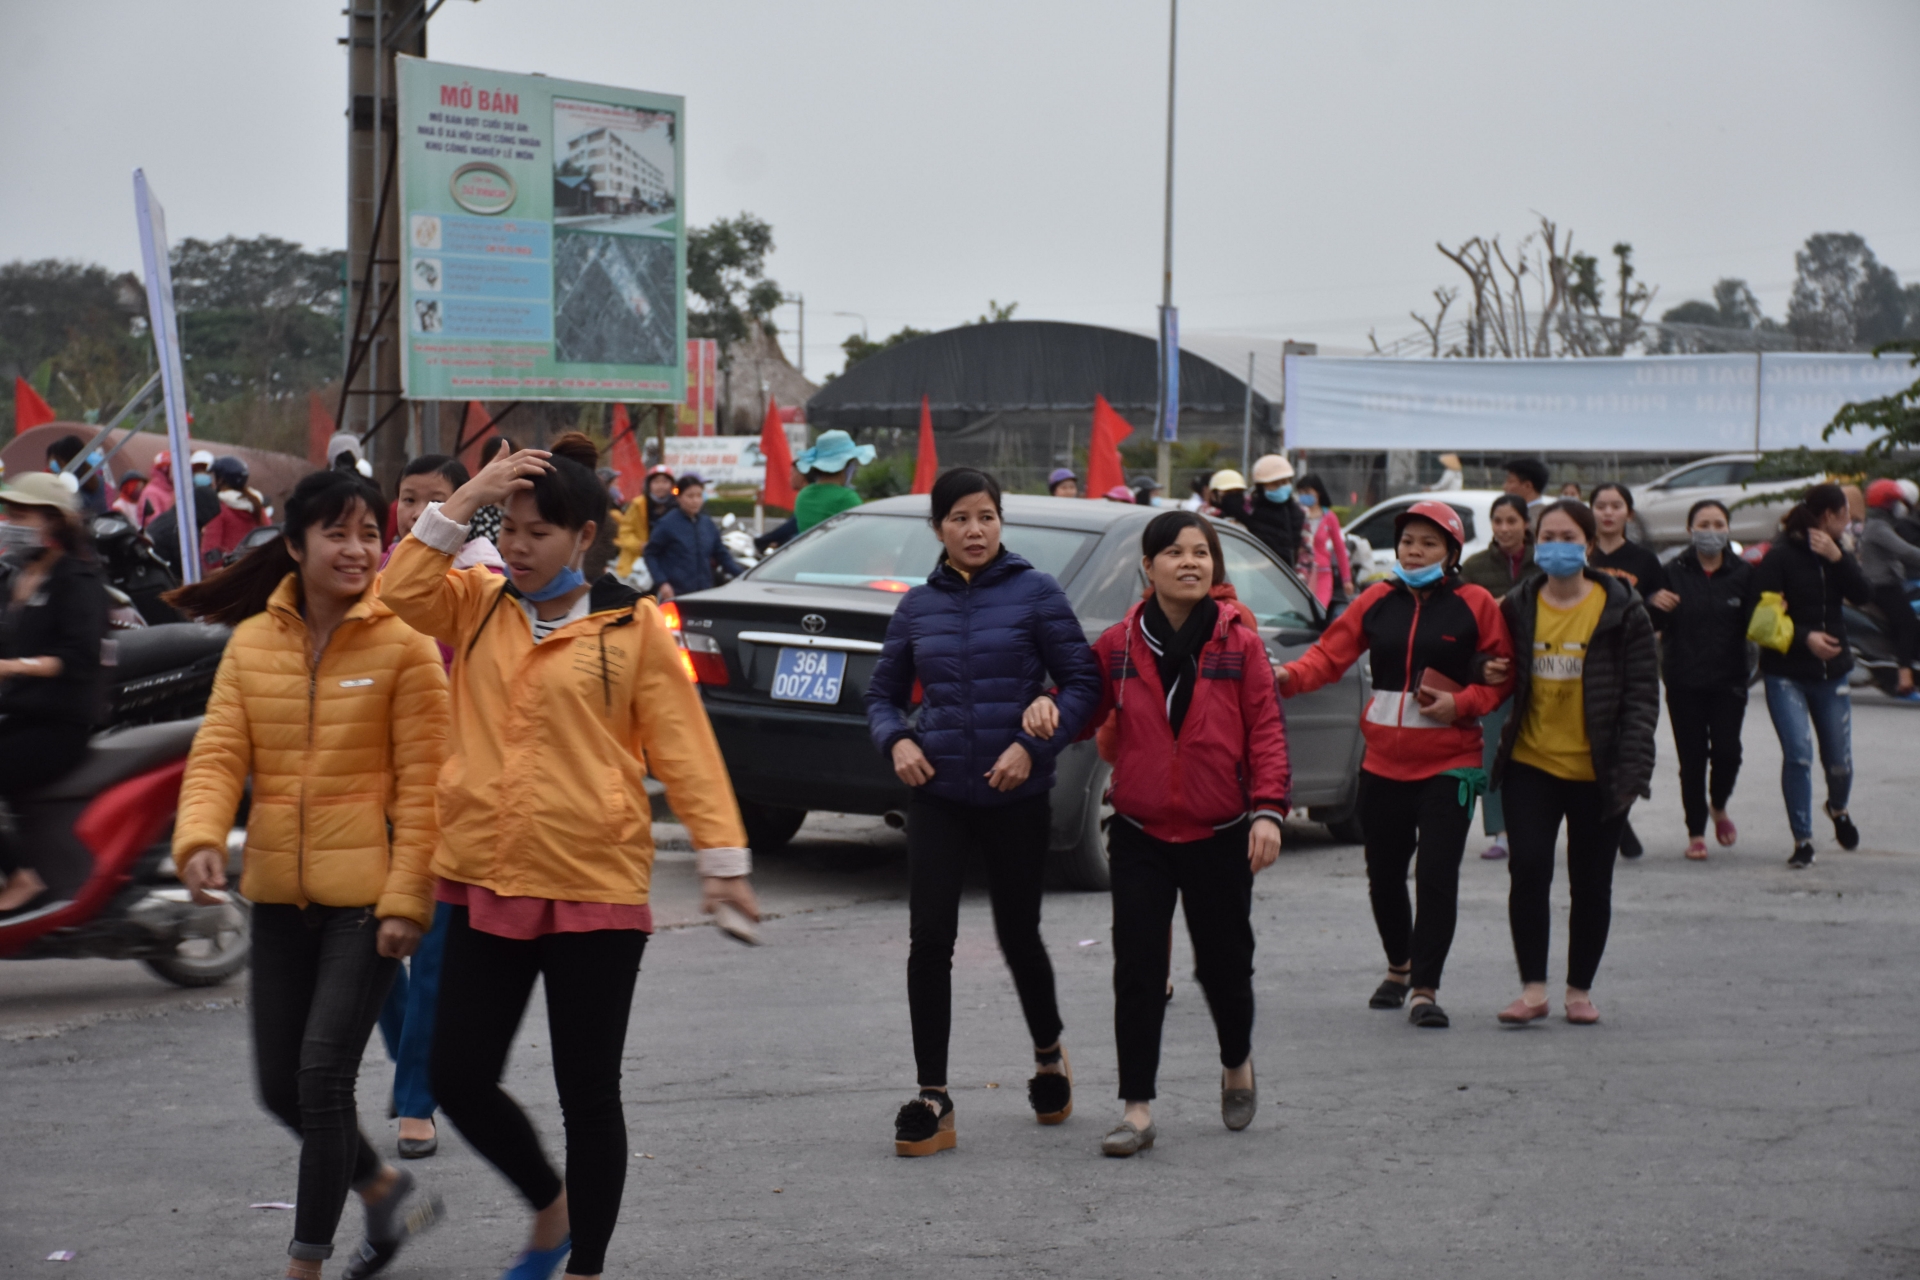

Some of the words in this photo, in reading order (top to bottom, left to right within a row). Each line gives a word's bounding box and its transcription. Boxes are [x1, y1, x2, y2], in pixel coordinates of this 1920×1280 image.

[441, 81, 473, 109] MỞ
[478, 87, 519, 115] BÁN
[793, 652, 828, 675] 36A
[775, 674, 838, 700] 007.45
